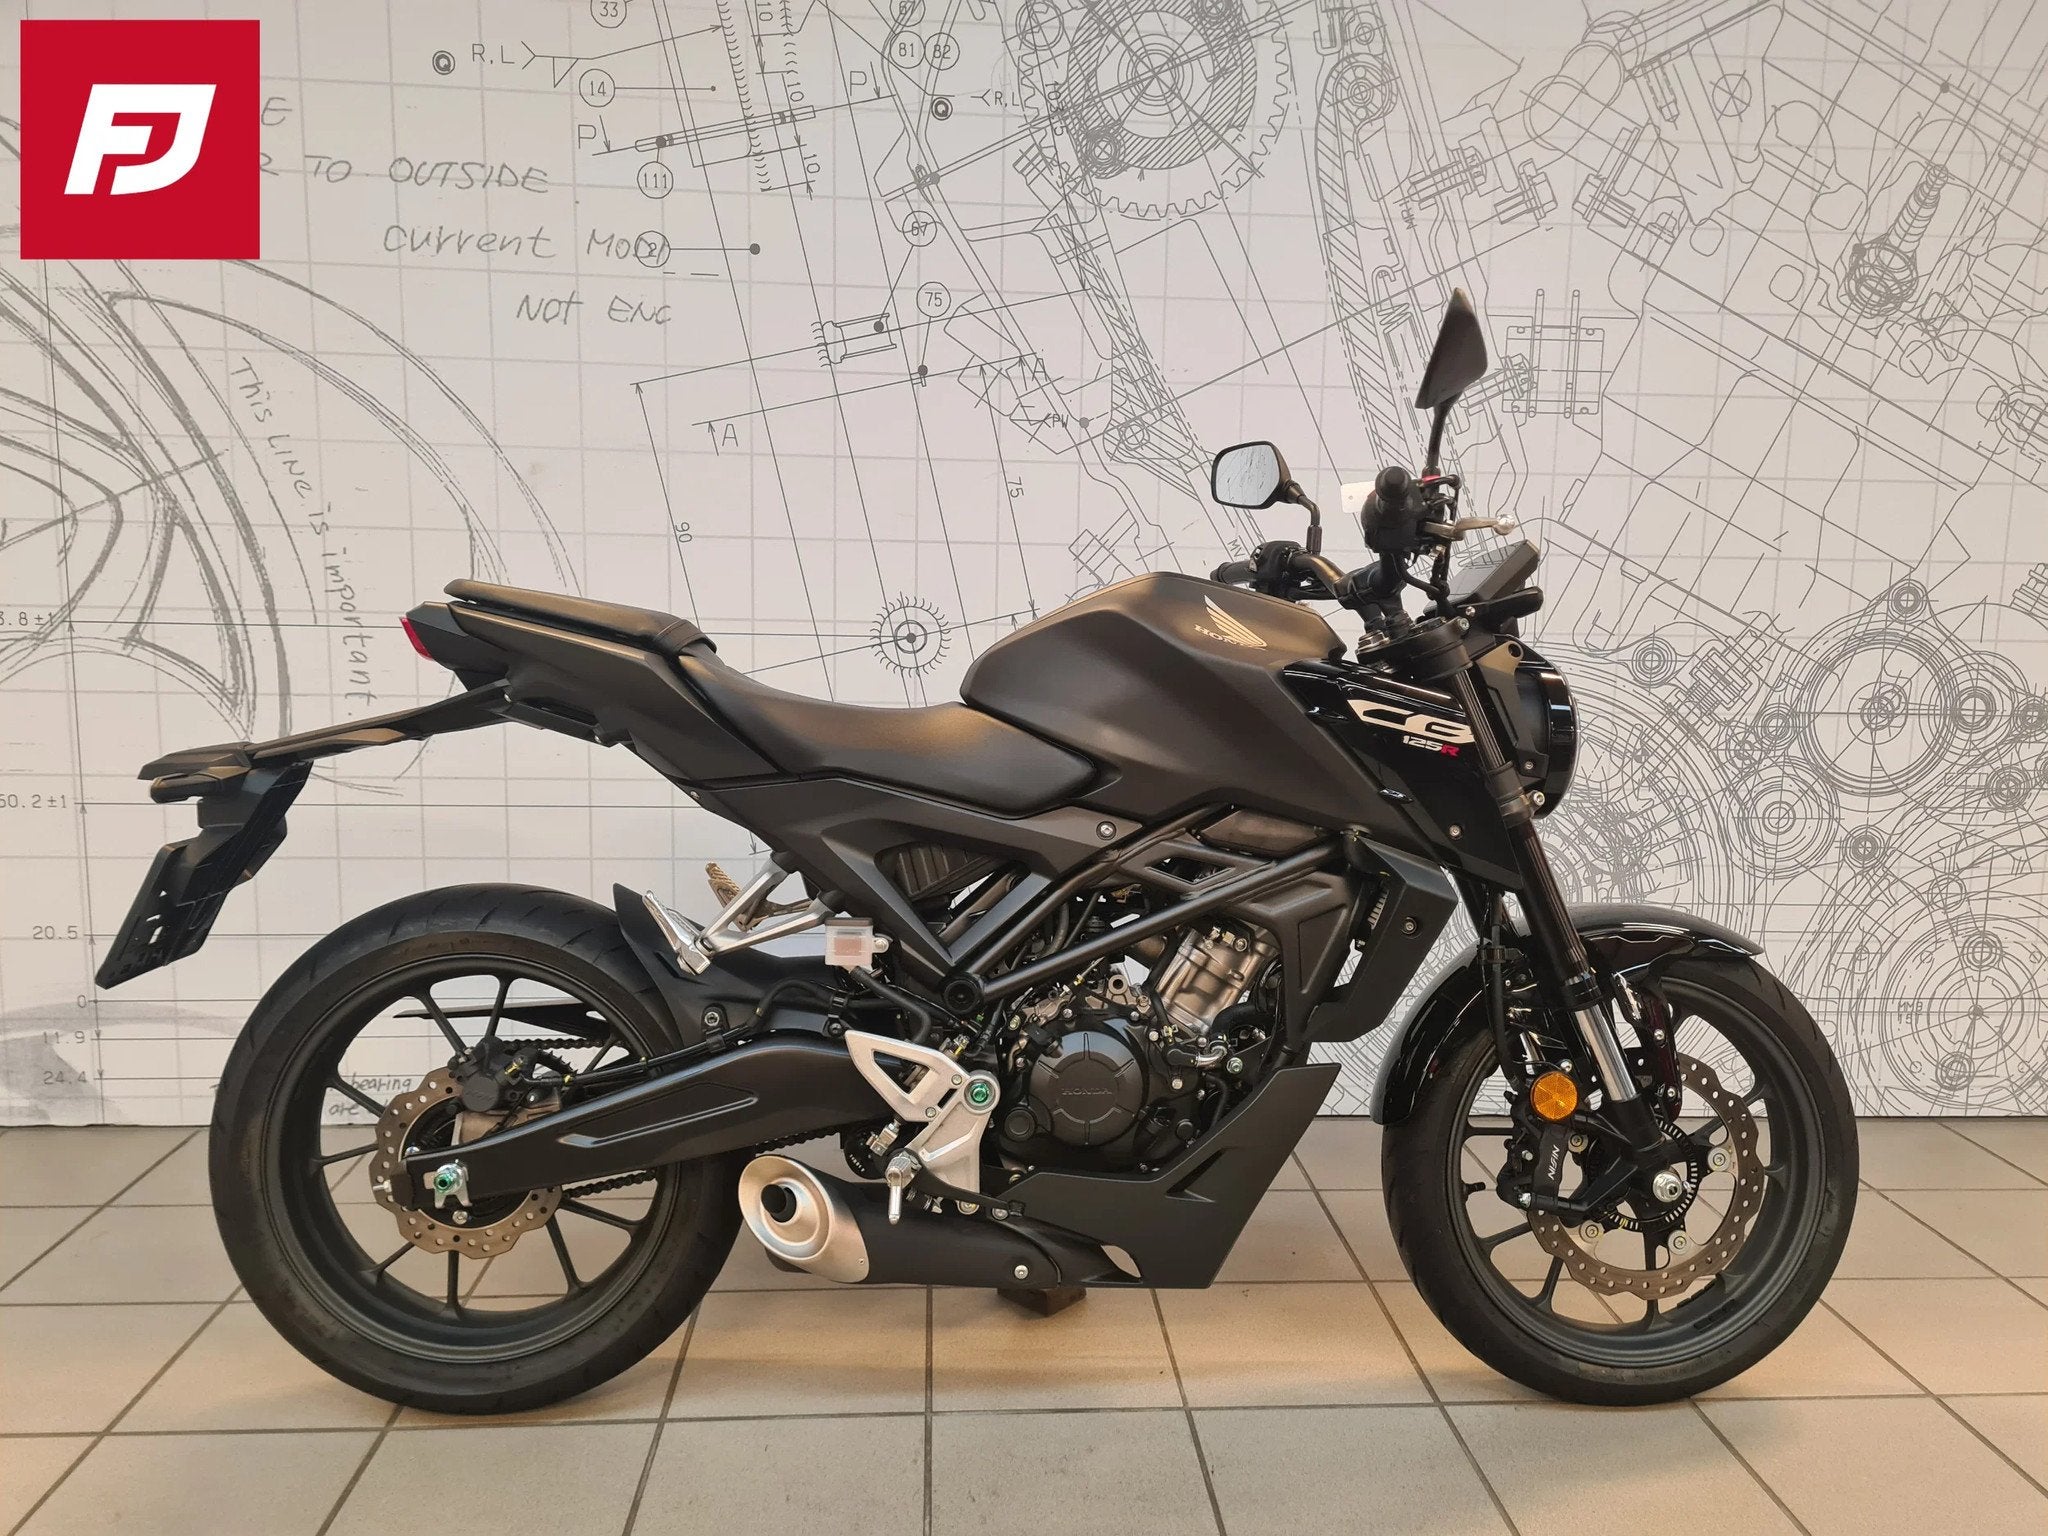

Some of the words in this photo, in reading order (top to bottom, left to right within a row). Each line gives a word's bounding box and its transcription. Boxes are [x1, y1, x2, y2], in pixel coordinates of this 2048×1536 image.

[898, 42, 916, 58] 81
[588, 80, 608, 97] 14
[786, 81, 806, 103] 10
[849, 70, 868, 97] P
[577, 124, 598, 149] P
[304, 154, 353, 184] TO
[388, 156, 549, 194] OUTSIDE
[803, 153, 822, 175] 10
[642, 172, 669, 190] 111
[924, 291, 943, 308] 75
[230, 356, 274, 423] This
[721, 423, 739, 447] A
[1007, 475, 1025, 499] 75
[674, 521, 694, 544] 90
[1403, 734, 1461, 758] 125R
[32, 925, 79, 940] 20.5
[76, 994, 87, 1009] 0
[42, 1030, 86, 1044] 11.9
[43, 1070, 87, 1085] 24.4
